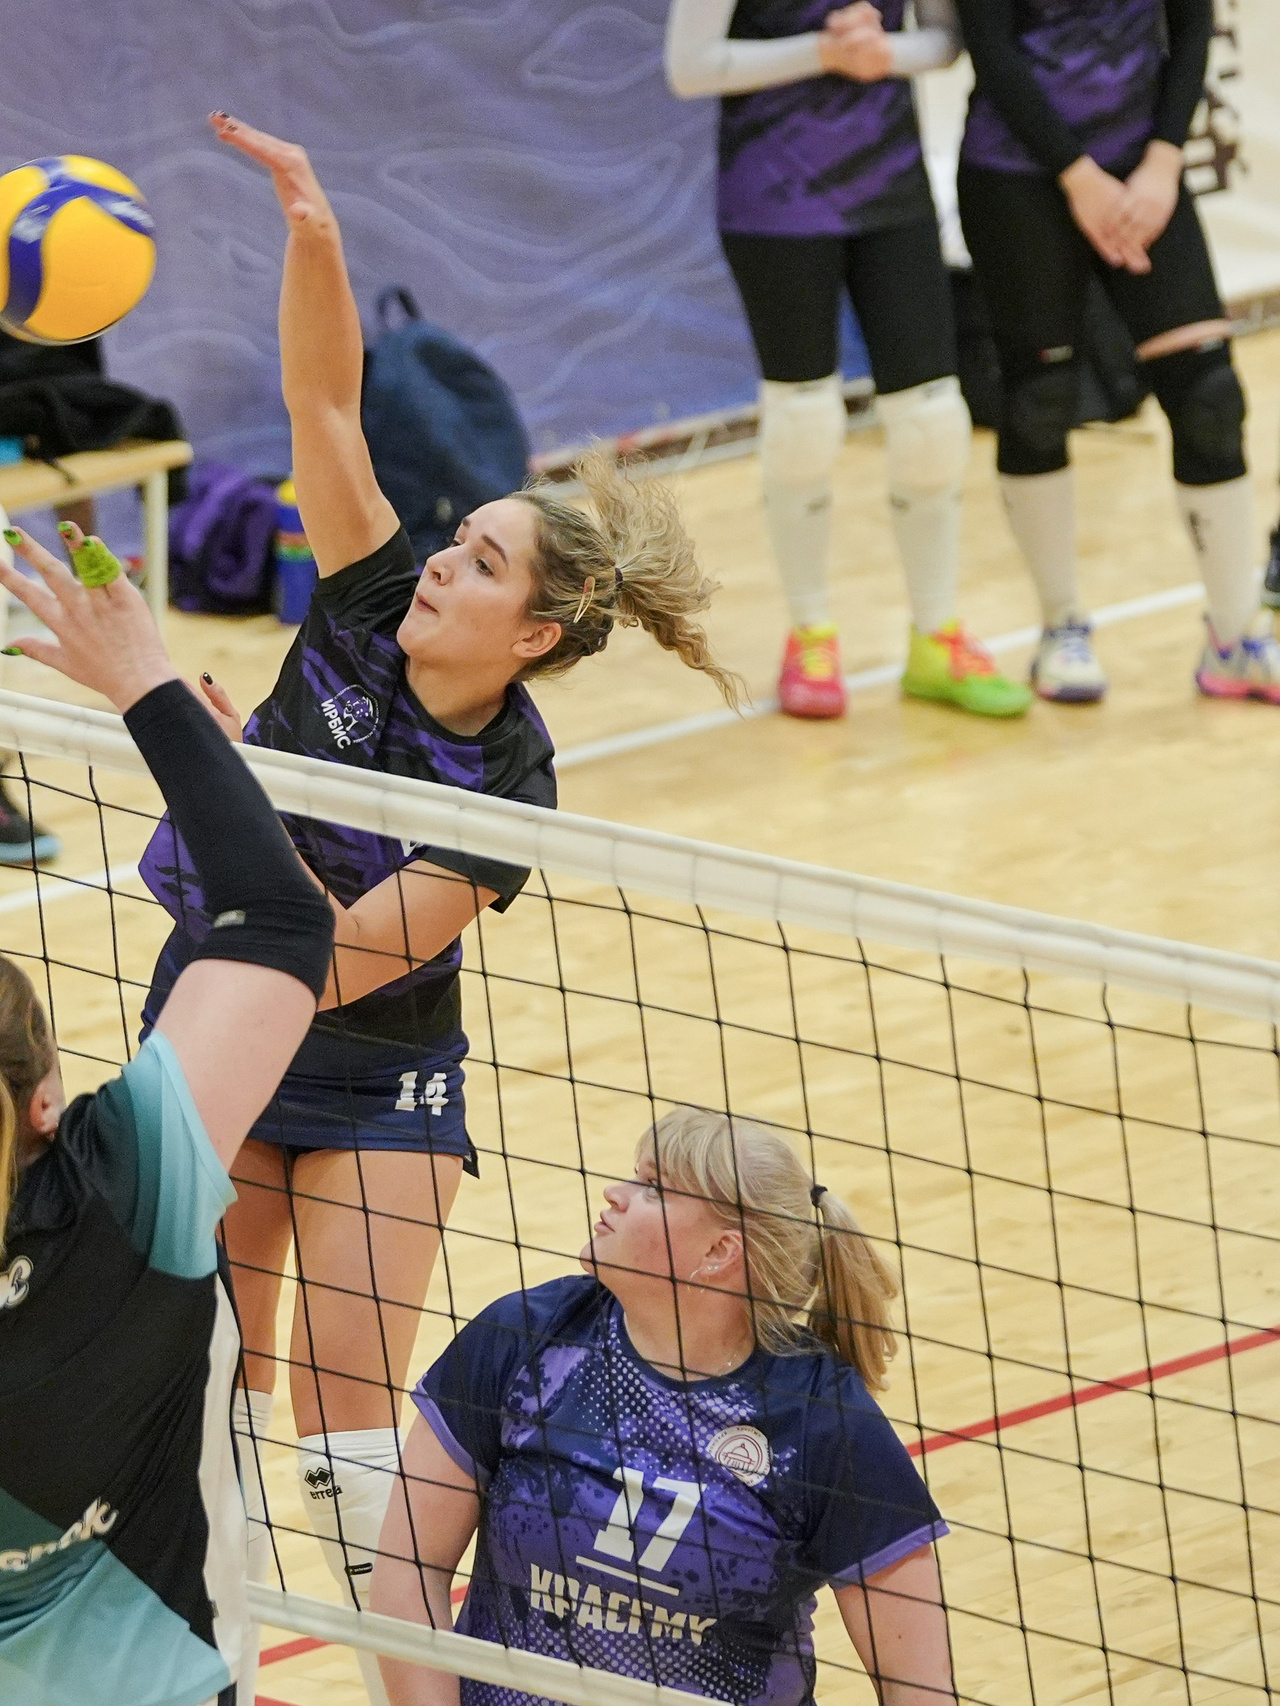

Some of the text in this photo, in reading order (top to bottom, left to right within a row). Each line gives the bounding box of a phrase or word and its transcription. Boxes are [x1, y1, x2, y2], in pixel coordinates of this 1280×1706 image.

[321, 698, 352, 749] ИРБИС
[394, 1070, 449, 1116] 14
[593, 1466, 708, 1573] 17
[530, 1562, 718, 1647] КРАСГМУ
